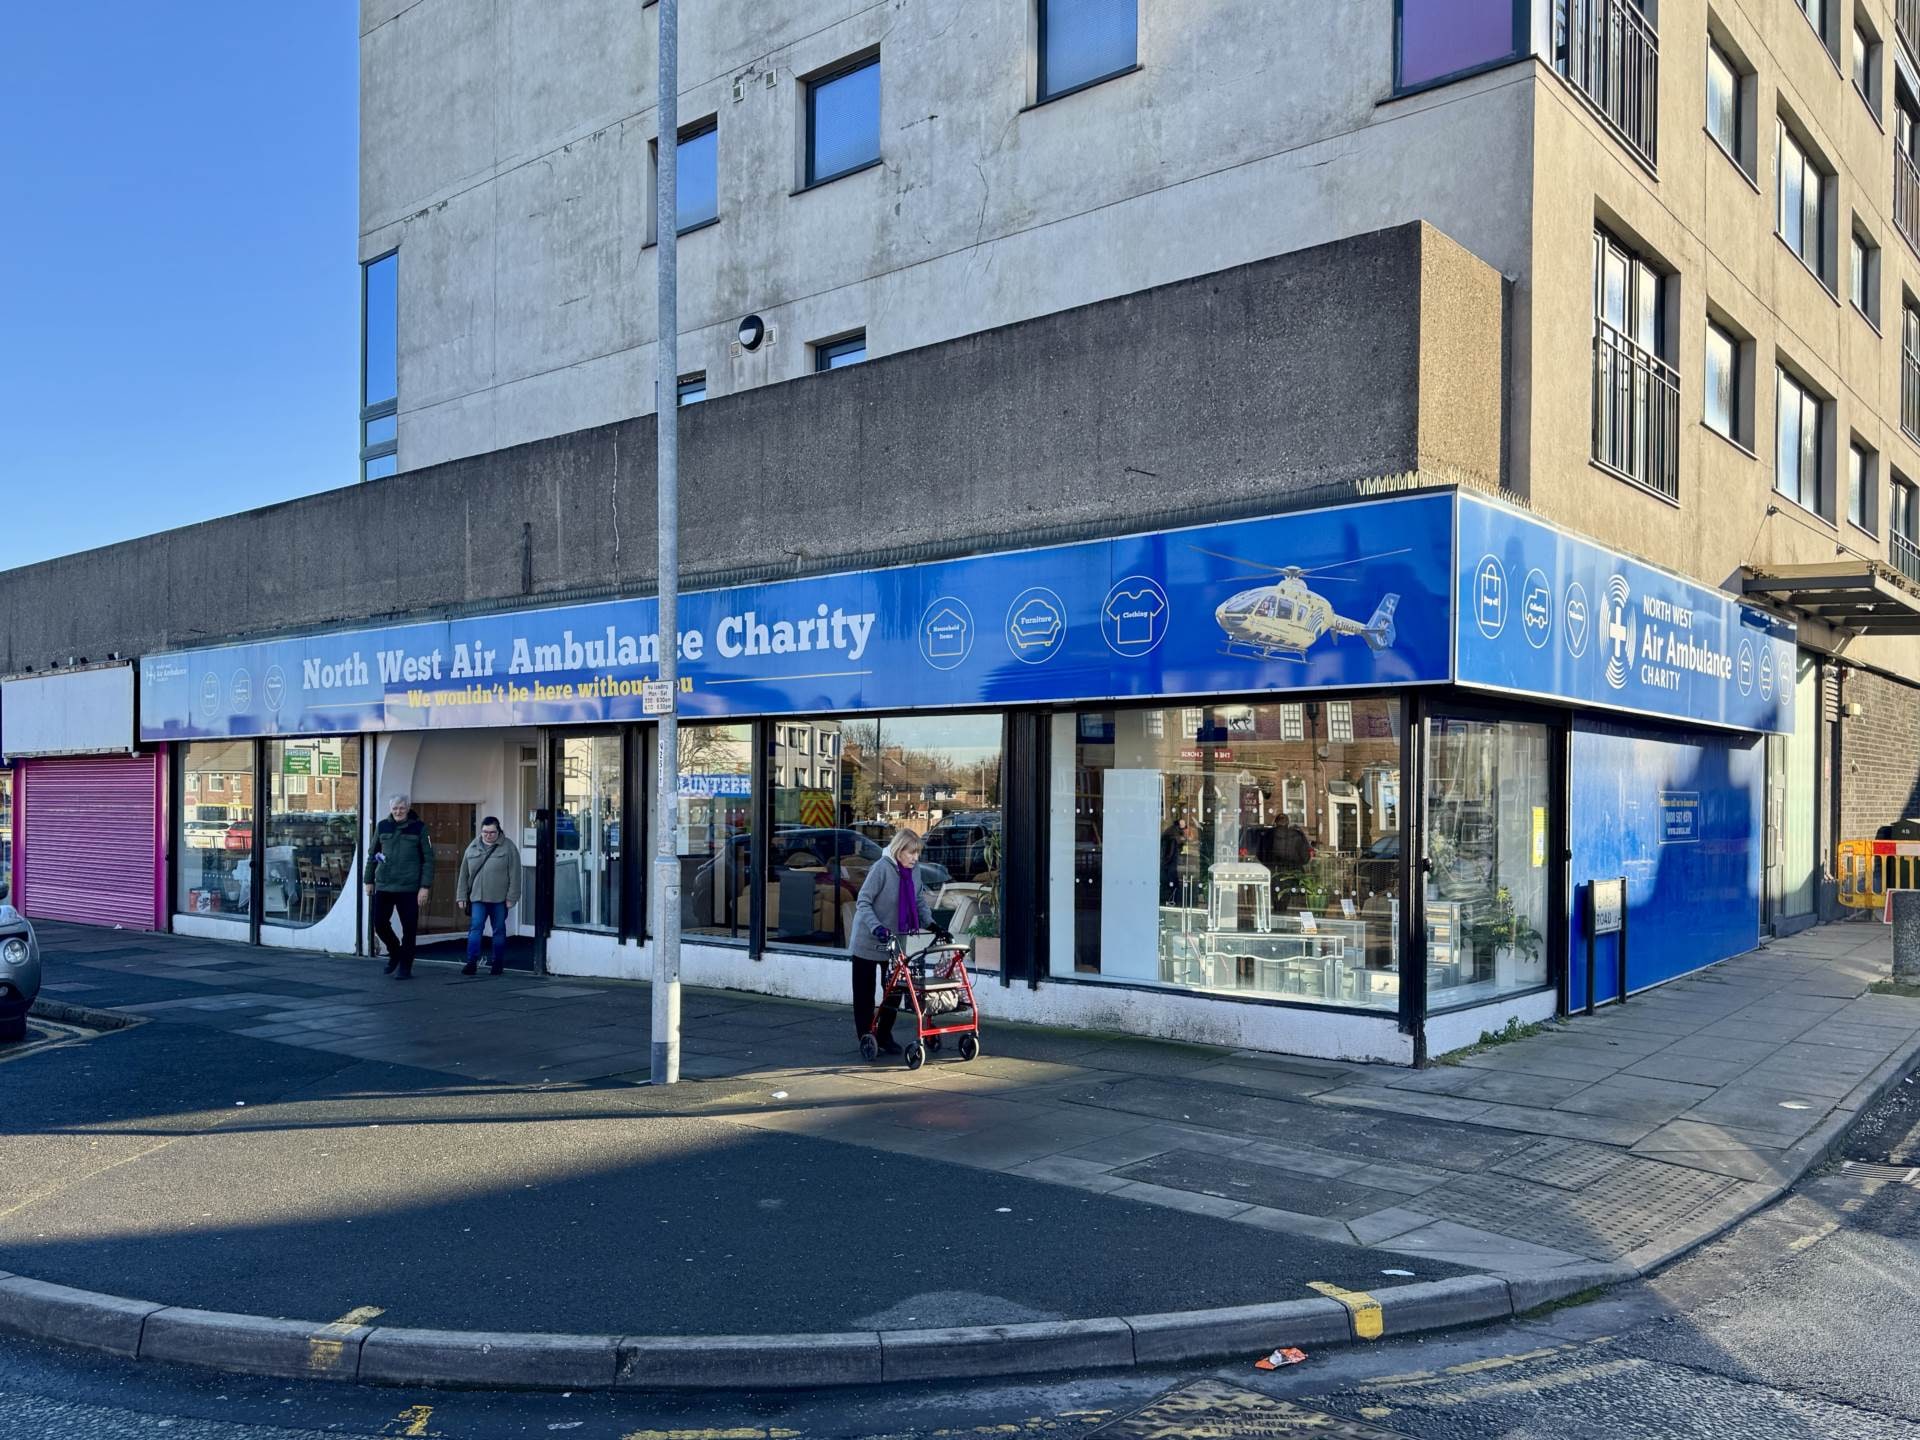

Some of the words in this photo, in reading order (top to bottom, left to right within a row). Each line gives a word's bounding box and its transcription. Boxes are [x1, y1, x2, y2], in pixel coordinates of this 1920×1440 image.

[1021, 616, 1052, 625] Furniture
[1122, 610, 1148, 619] Clothing
[1643, 594, 1671, 622] NORTH
[1672, 605, 1693, 629] WEST
[303, 652, 369, 689] North
[376, 649, 442, 683] West
[450, 641, 496, 678] Air
[508, 626, 704, 674] Ambulane
[716, 604, 875, 660] Charity
[1641, 624, 1664, 662] Air
[1666, 631, 1732, 680] Ambulance
[1641, 664, 1680, 691] CHARITY
[407, 690, 431, 708] We
[435, 683, 504, 707] wouldn't
[508, 682, 529, 702] be
[534, 680, 573, 700] here
[1597, 912, 1611, 925] ROAD
